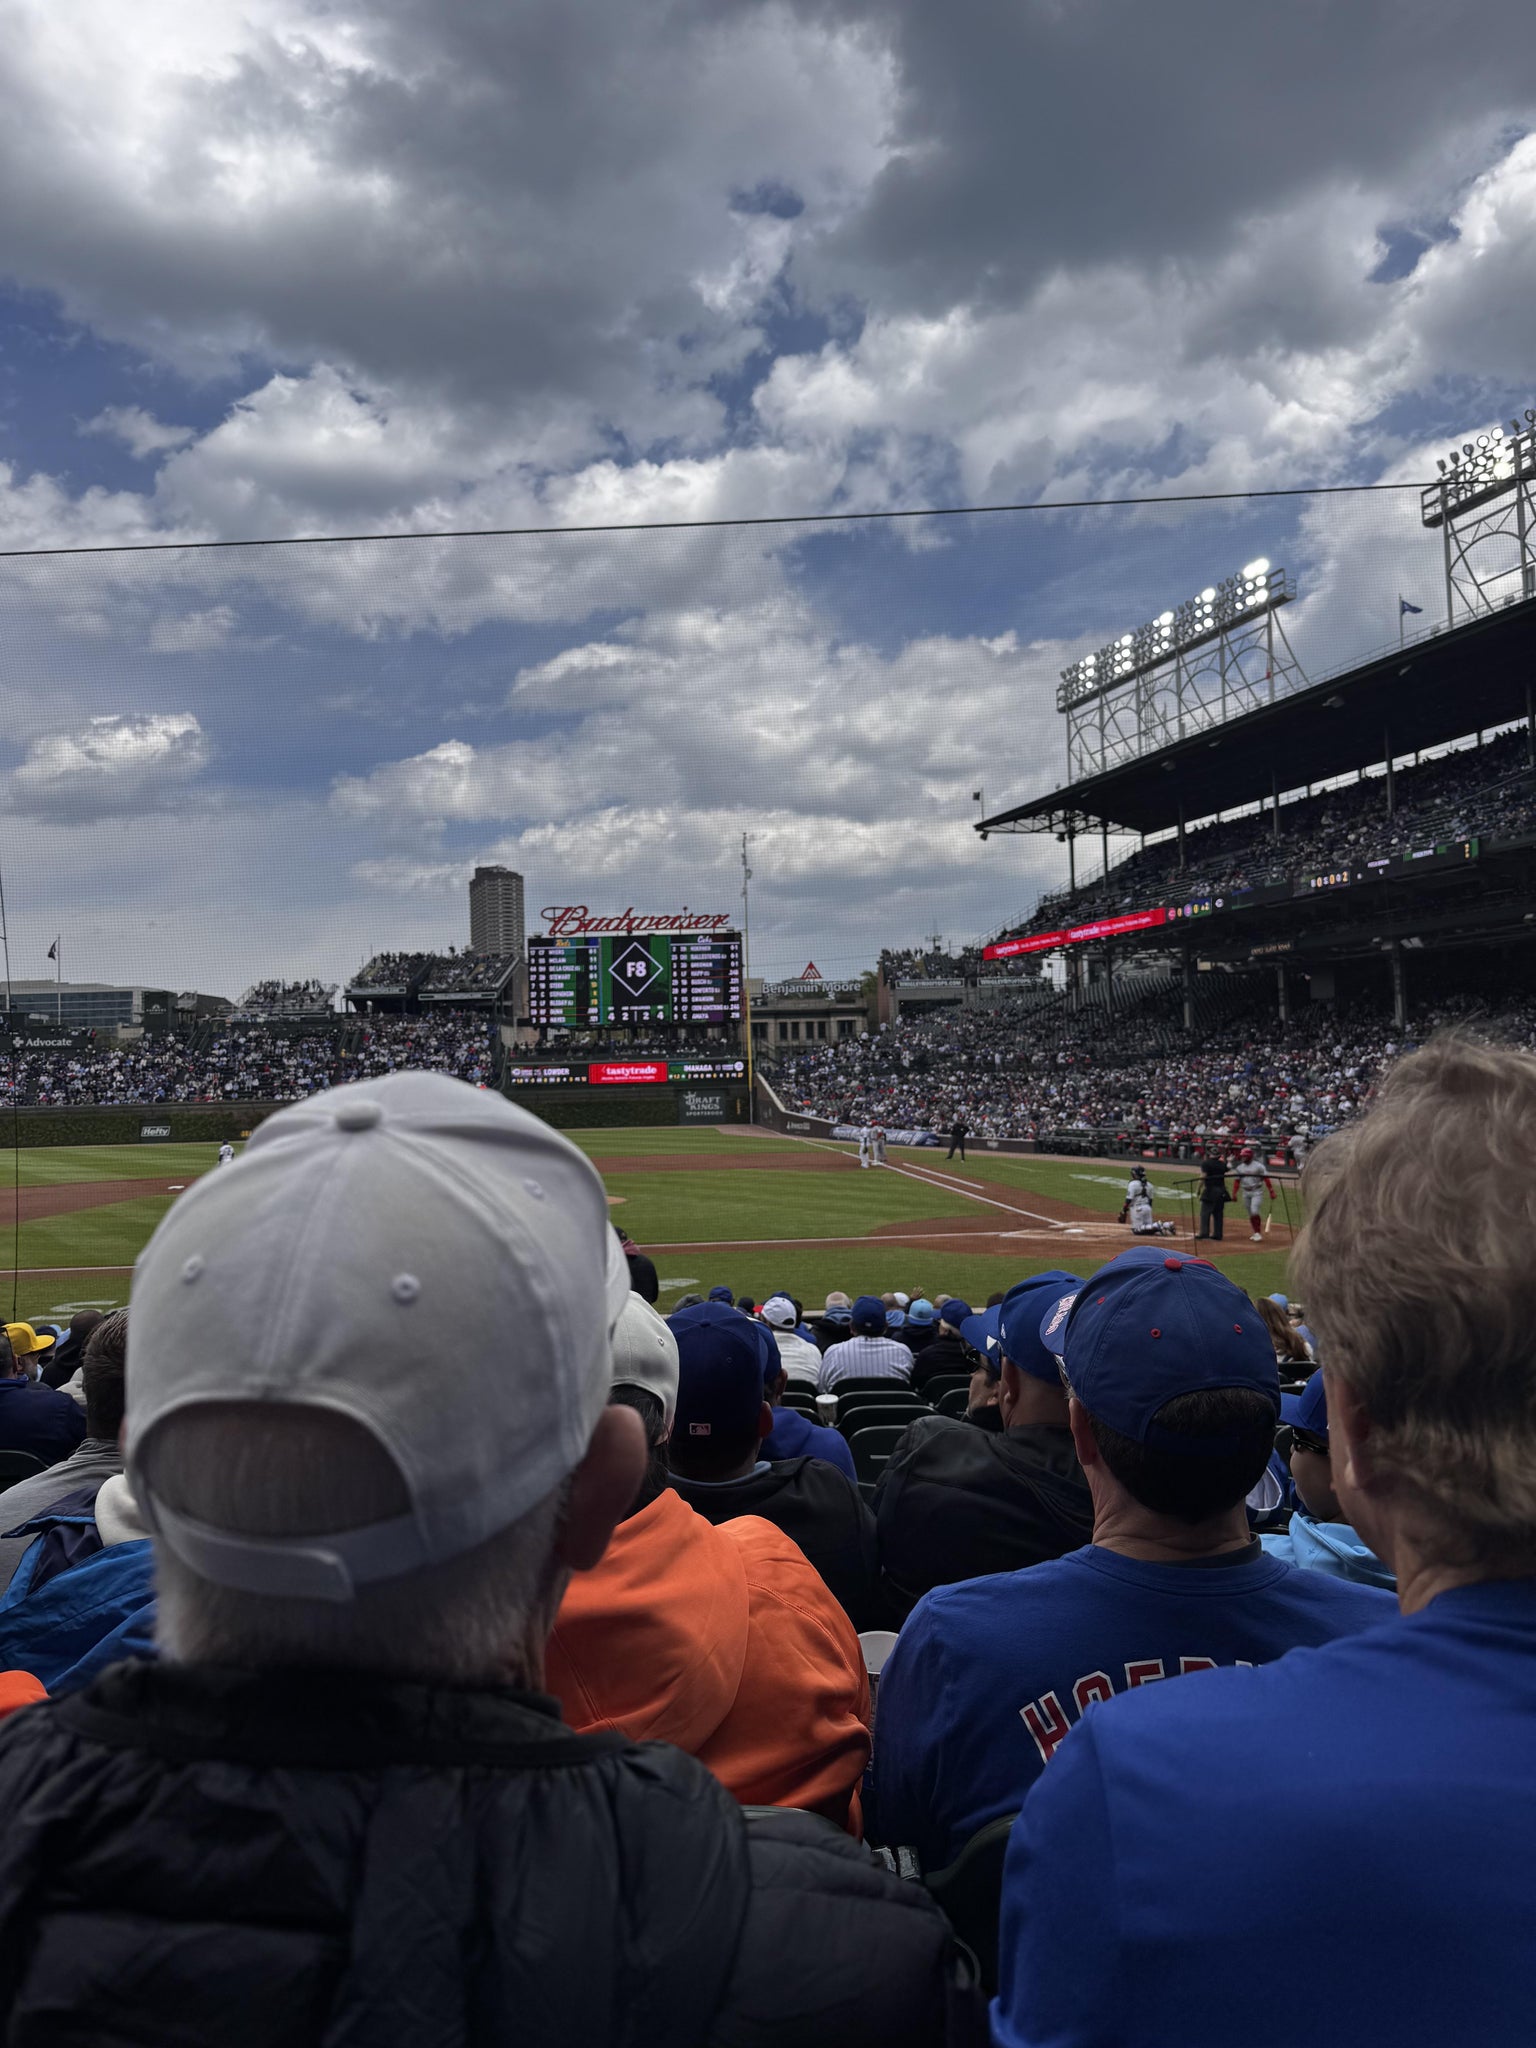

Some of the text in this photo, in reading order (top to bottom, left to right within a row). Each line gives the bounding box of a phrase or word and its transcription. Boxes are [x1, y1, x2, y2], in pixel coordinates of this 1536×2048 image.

[541, 905, 729, 936] Budweiser
[626, 962, 647, 978] F8
[762, 982, 861, 996] Benjamin Moore
[607, 1012, 615, 1021] 4
[622, 1011, 629, 1021] 2
[643, 1011, 650, 1020] 2
[657, 1011, 664, 1020] 4
[25, 1037, 72, 1048] Advocate
[606, 1065, 657, 1076] tastytrade
[143, 1127, 169, 1136] Hefty
